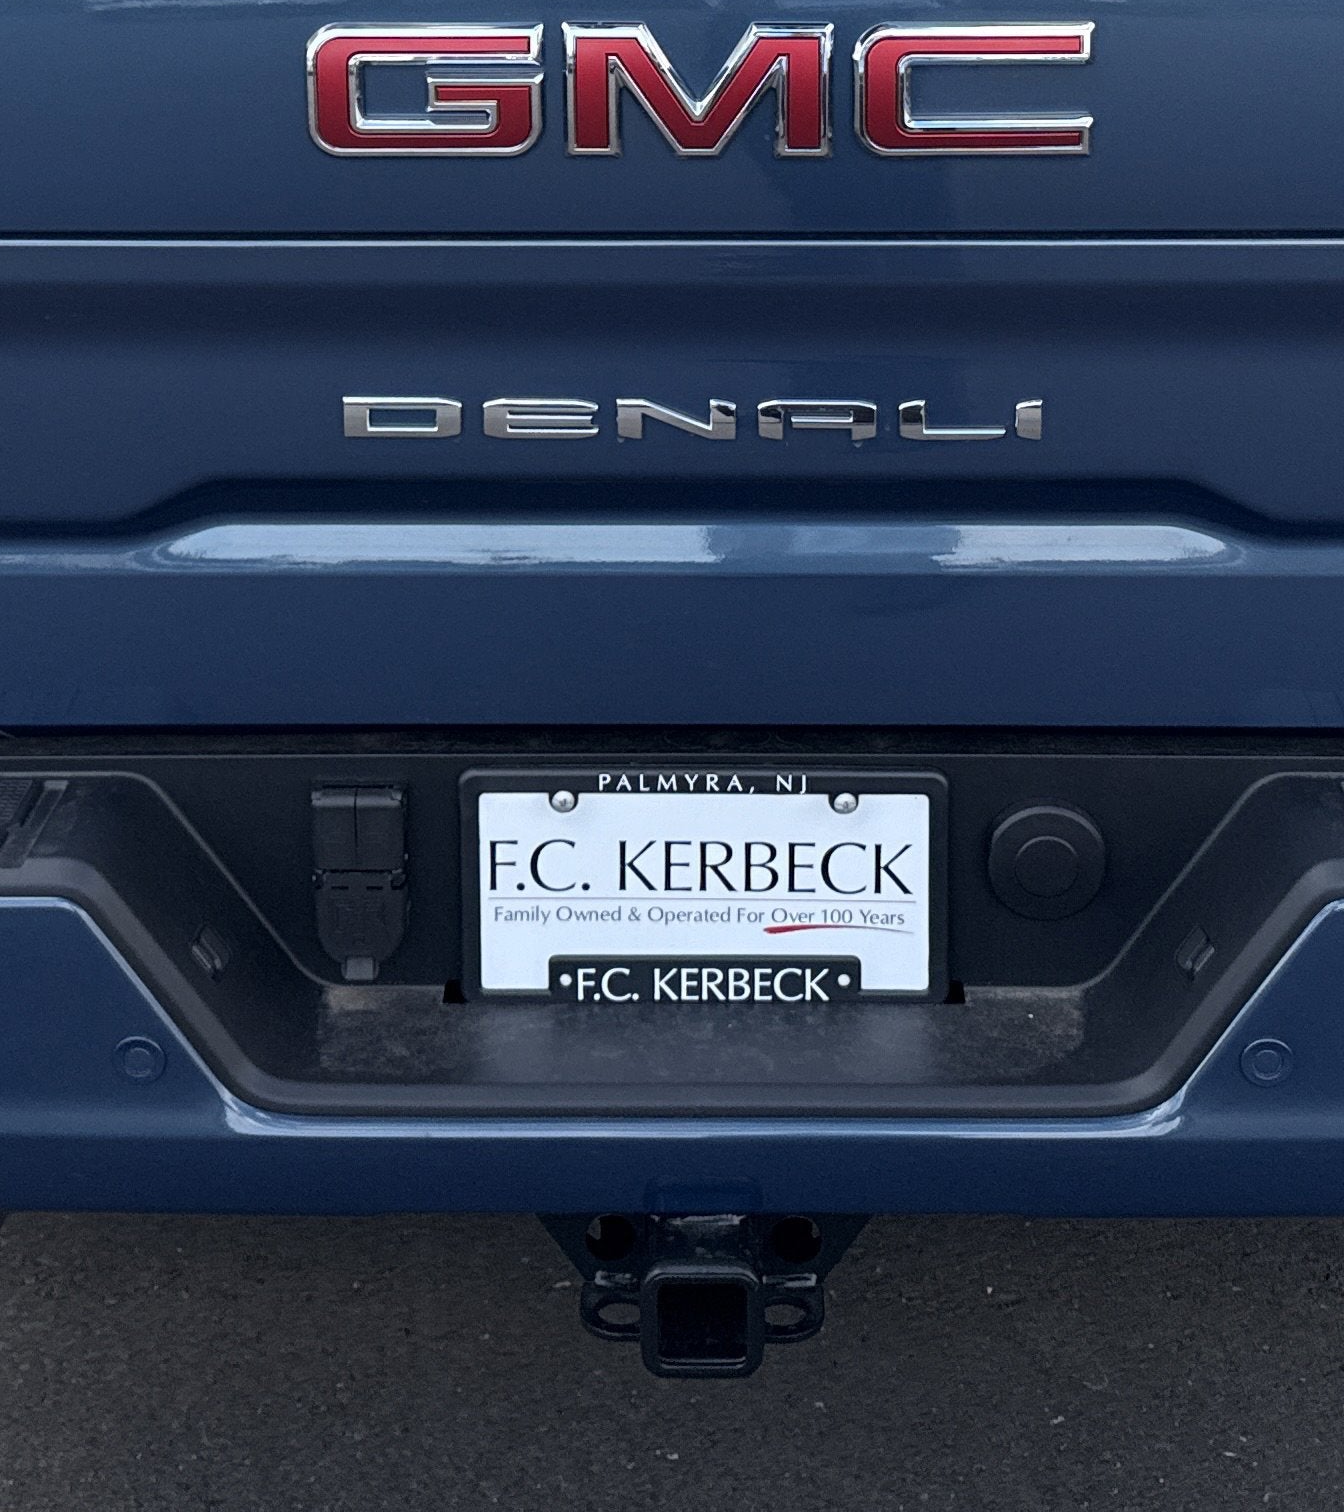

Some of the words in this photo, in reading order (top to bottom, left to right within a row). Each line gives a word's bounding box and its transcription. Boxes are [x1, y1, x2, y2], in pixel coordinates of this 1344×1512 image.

[304, 21, 1097, 159] GMC
[342, 396, 1044, 442] DENALI
[598, 773, 755, 794] PALMYRA,
[776, 773, 807, 794] NJ
[488, 838, 591, 892] F.C.
[618, 839, 914, 895] KERBECK
[494, 904, 552, 925] Family
[556, 905, 622, 922] Owned
[627, 906, 642, 922] &
[647, 905, 731, 925] Operated
[737, 906, 766, 923] For
[771, 907, 815, 923] Over
[821, 909, 853, 923] 100
[859, 908, 905, 925] Years
[576, 967, 640, 1002] F.C.
[653, 967, 831, 1002] KERBECK
